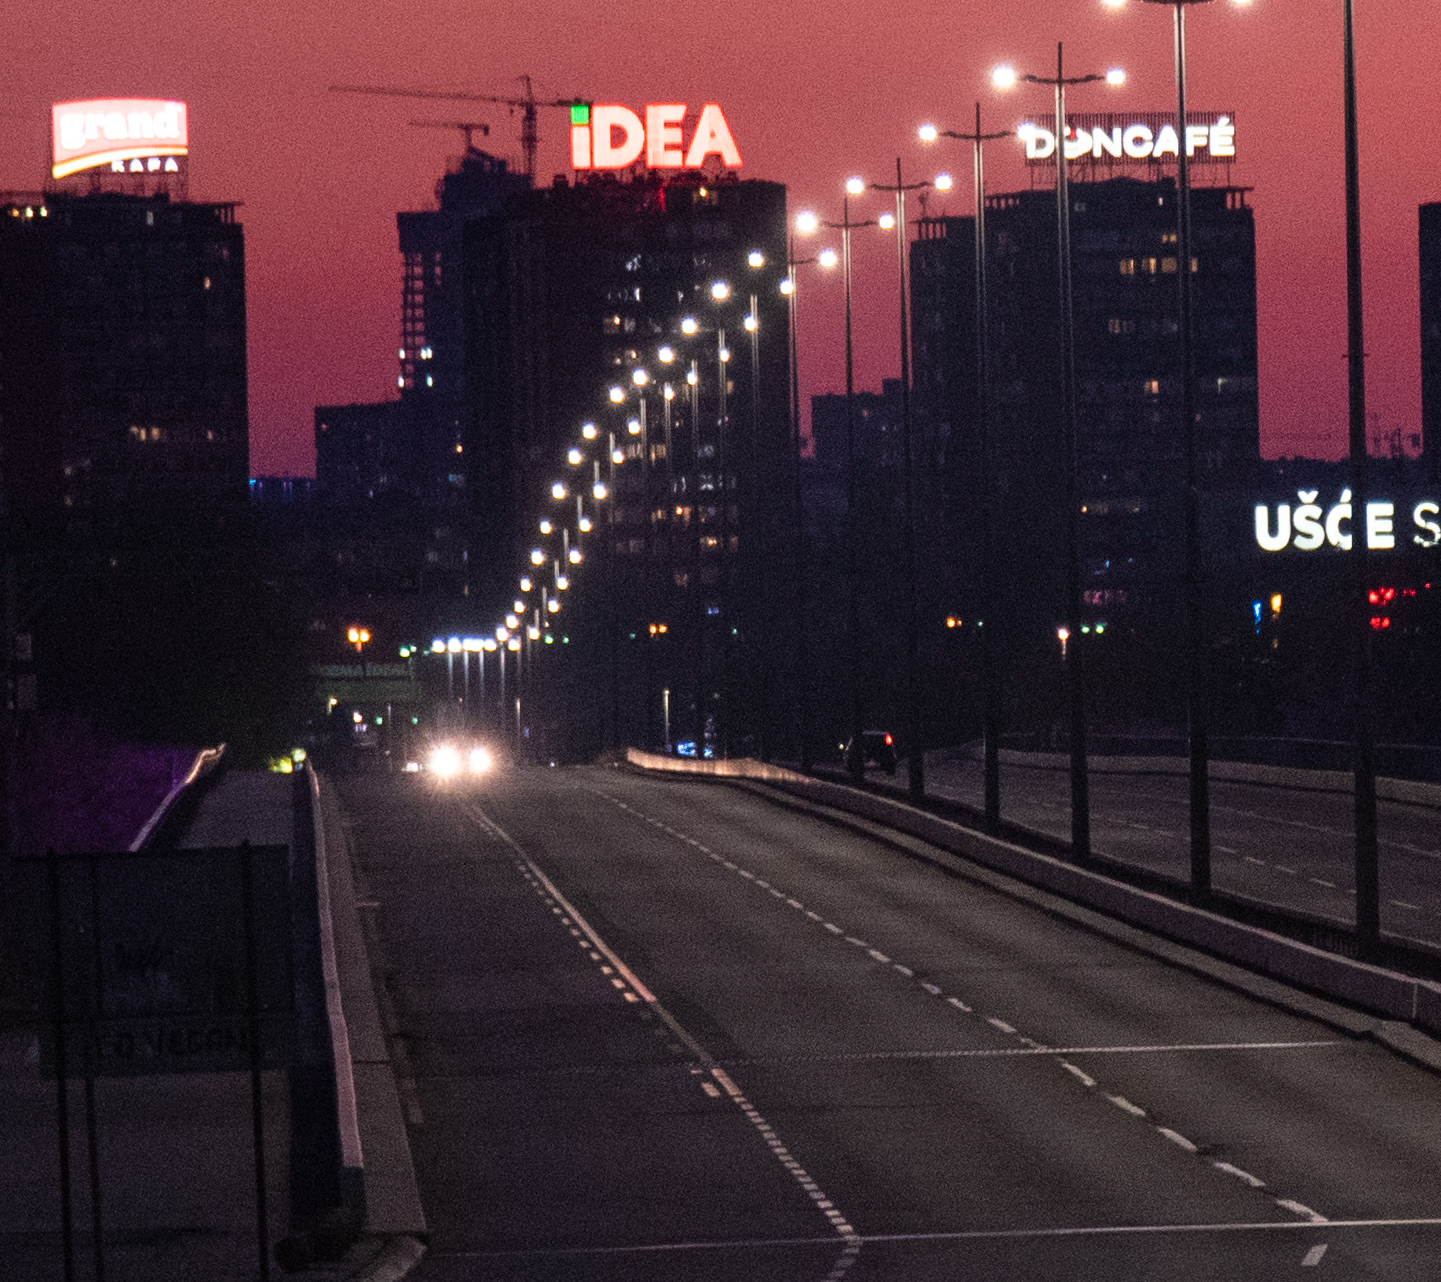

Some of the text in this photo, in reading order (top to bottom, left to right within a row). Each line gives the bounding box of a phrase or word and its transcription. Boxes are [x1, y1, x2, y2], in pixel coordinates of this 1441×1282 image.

[60, 102, 181, 150] grand
[1024, 115, 1236, 159] DONCAFÉ
[1255, 489, 1395, 552] UŠĆE
